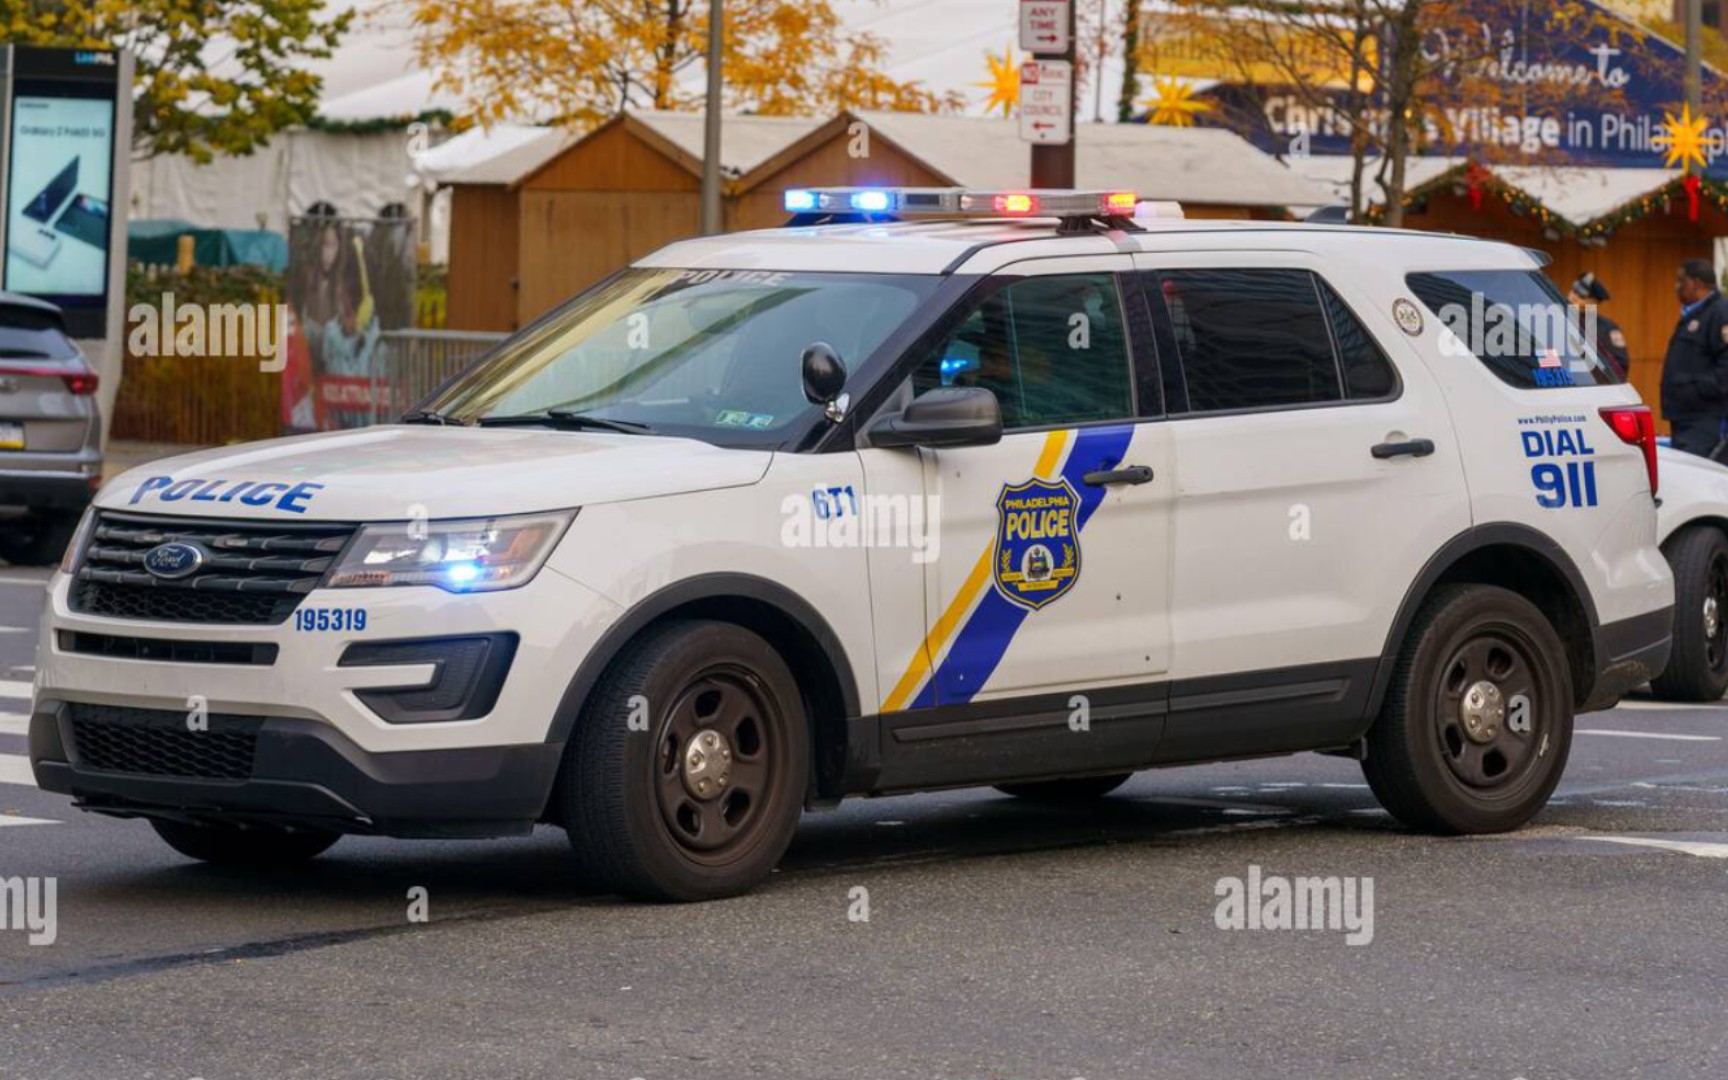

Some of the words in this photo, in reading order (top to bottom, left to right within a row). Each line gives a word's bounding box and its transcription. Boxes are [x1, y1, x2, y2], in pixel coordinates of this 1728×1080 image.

[1030, 7, 1057, 17] ANY
[1030, 21, 1057, 31] TIME
[1589, 42, 1631, 87] to
[1032, 90, 1054, 101] CITY
[1023, 104, 1064, 116] COUNCIL
[1446, 107, 1561, 152] Village
[1568, 112, 1593, 148] in
[1520, 428, 1595, 458] DIAL
[128, 476, 325, 514] POLICE
[1530, 461, 1598, 509] 911
[811, 485, 858, 520] 6T1
[1004, 495, 1070, 510] PHILADELPHIA
[1006, 509, 1070, 541] POLICE
[151, 547, 186, 568] Ford
[295, 608, 367, 631] 195319
